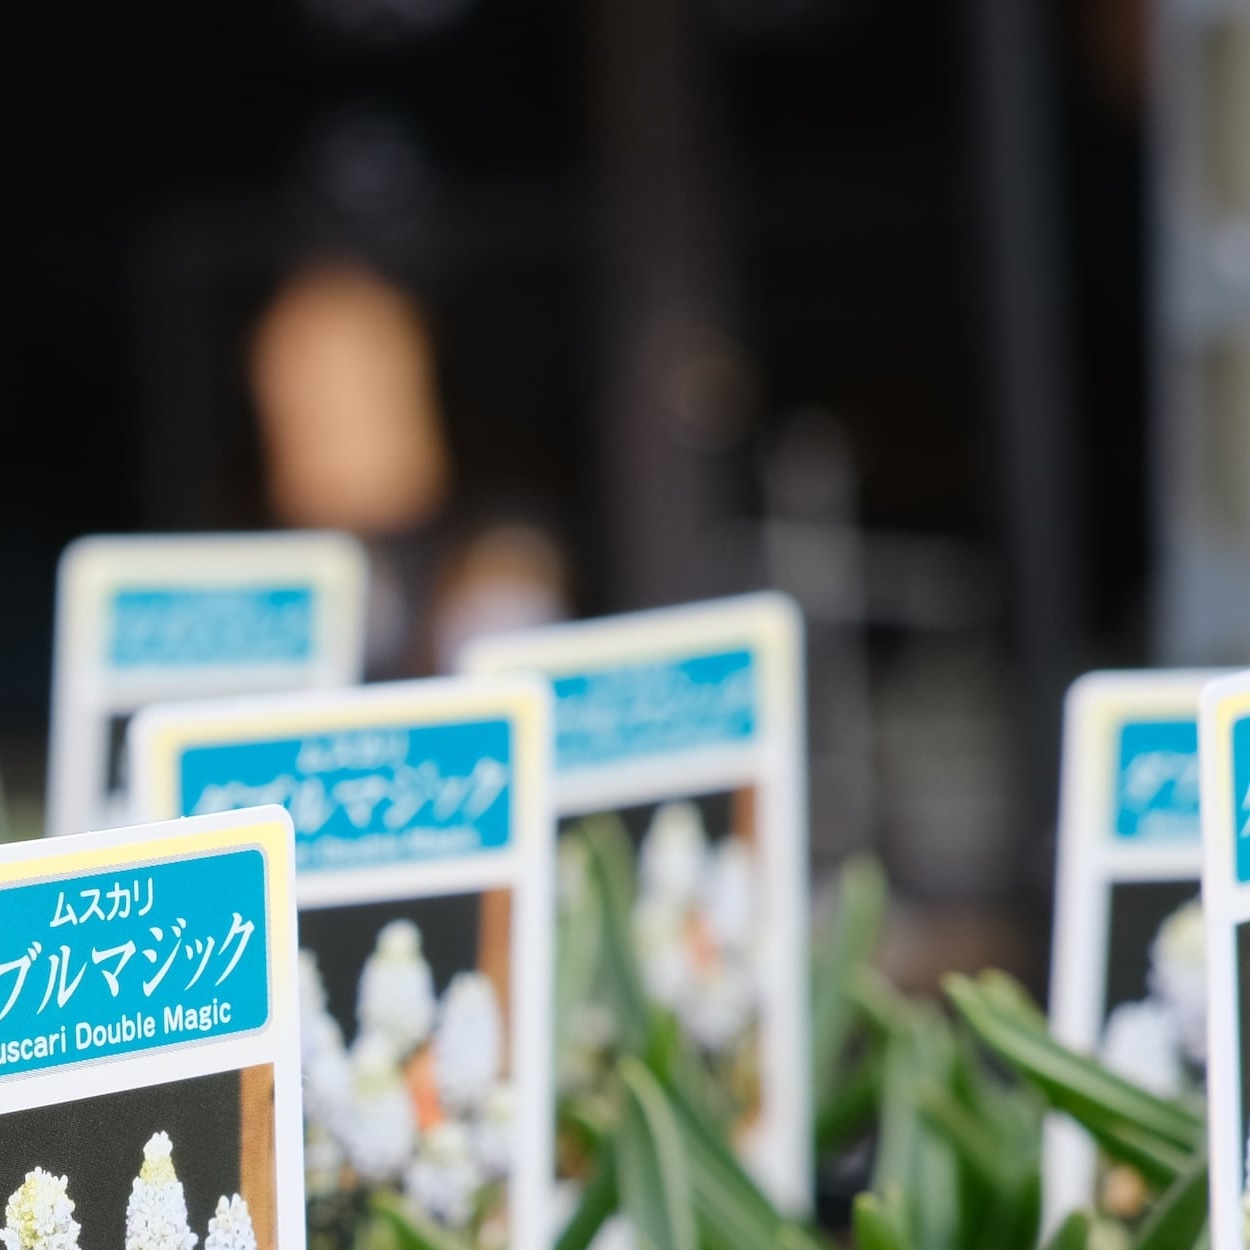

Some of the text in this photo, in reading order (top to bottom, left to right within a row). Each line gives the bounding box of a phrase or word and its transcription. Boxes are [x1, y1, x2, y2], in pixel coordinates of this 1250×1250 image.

[49, 877, 154, 928] ムスカリ
[75, 1010, 156, 1051] Double
[163, 998, 232, 1033] Magic
